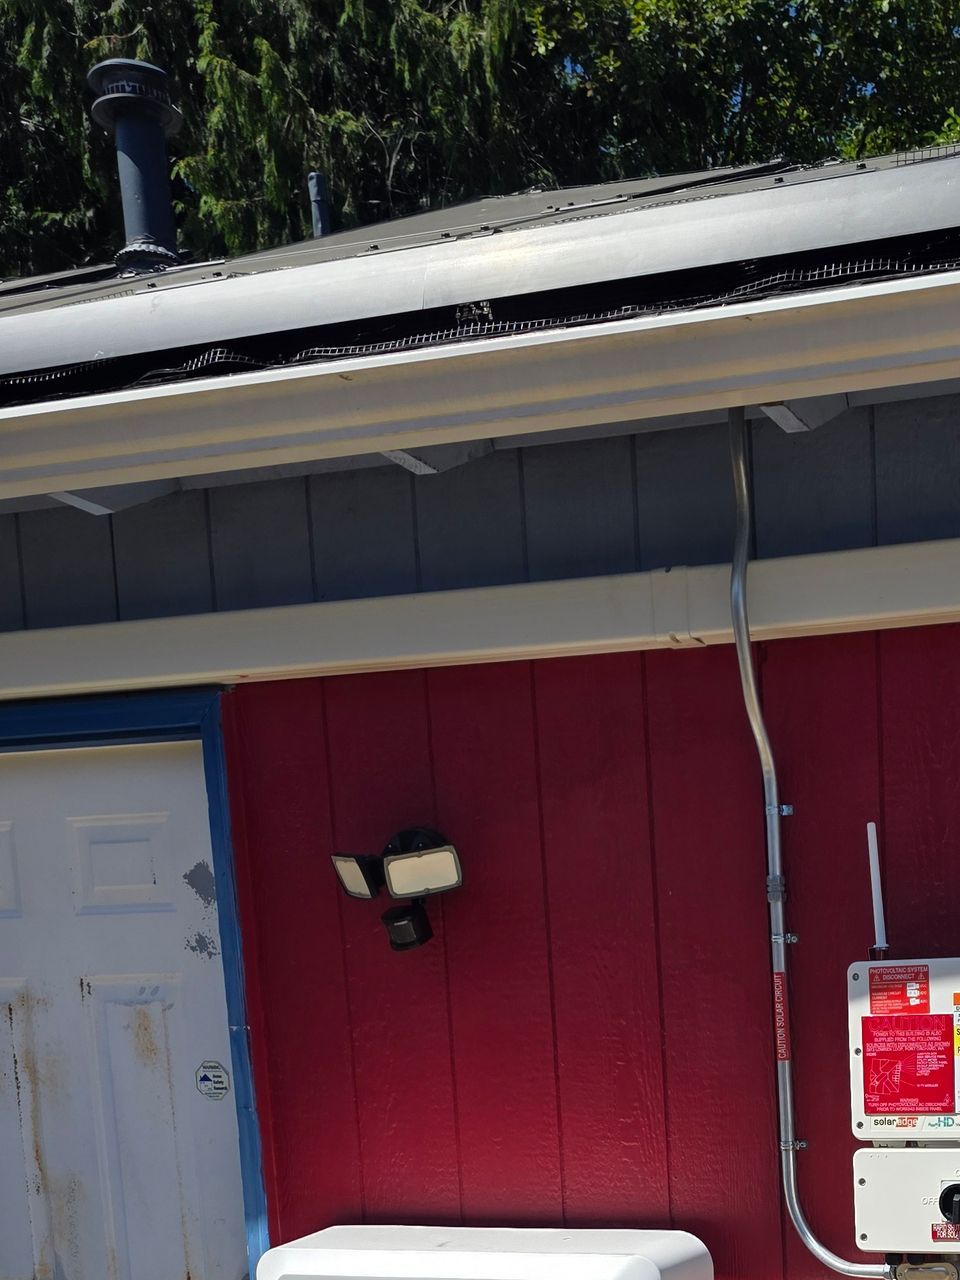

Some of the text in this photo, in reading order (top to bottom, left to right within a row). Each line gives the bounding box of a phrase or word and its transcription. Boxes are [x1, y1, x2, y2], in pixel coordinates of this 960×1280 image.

[774, 974, 786, 1059] CAUTION SOLAR CIRCUIT
[868, 1016, 946, 1031] CAUTION
[874, 1117, 918, 1127] solaredge
[938, 1117, 954, 1127] HD
[921, 1197, 938, 1205] OFF
